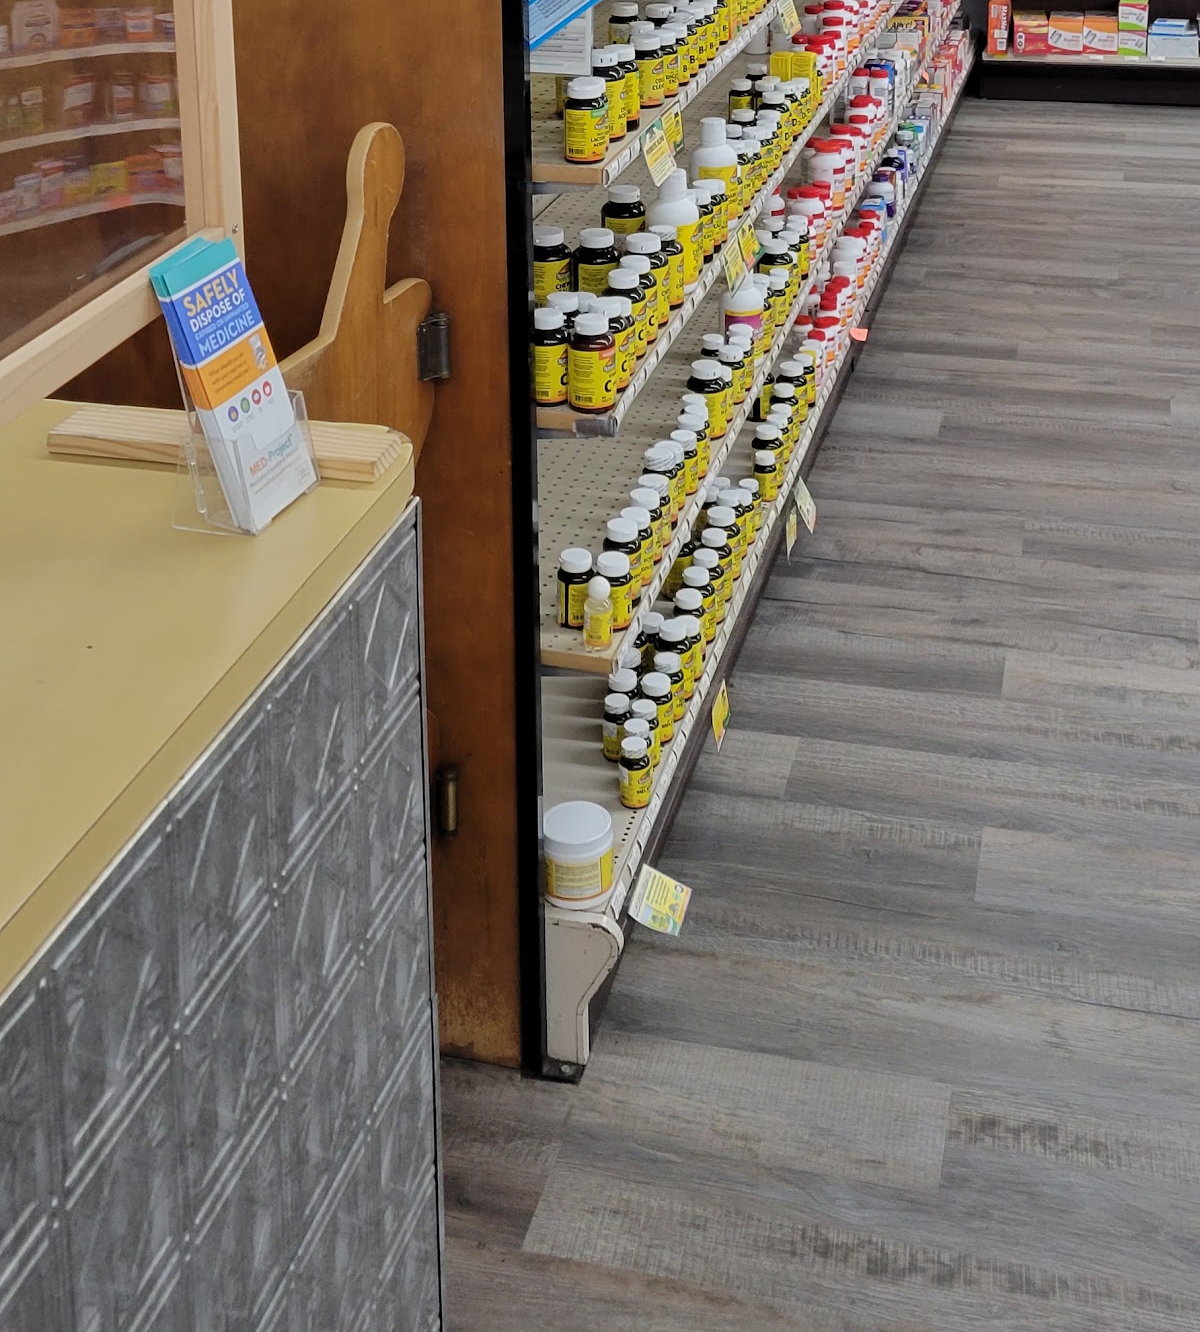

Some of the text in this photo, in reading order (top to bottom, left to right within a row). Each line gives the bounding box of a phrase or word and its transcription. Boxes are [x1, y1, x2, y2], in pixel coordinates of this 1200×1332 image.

[183, 267, 239, 317] SAFELY
[189, 288, 246, 333] DISPOSE OF
[198, 309, 256, 358] MEDICINE
